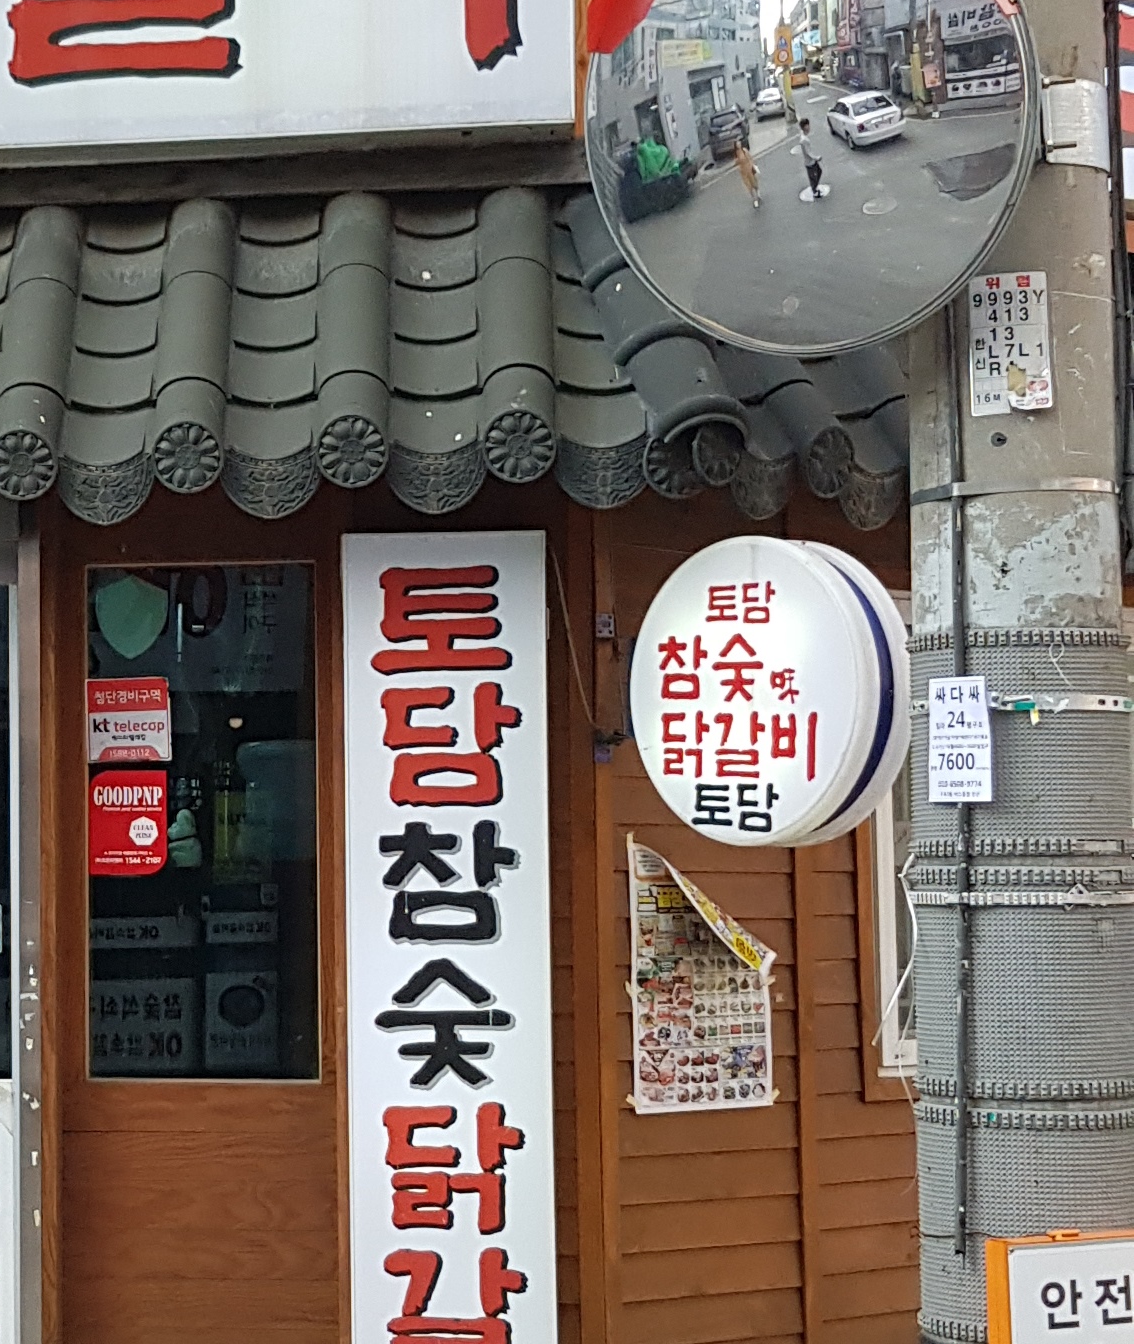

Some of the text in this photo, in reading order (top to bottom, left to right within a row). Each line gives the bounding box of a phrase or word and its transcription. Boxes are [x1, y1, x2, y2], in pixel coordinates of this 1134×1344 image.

[705, 580, 777, 625] 토담
[657, 633, 763, 703] 참숯
[93, 718, 165, 734] kt telecop
[660, 711, 818, 782] 닭갈비
[938, 753, 975, 770] 7600
[94, 786, 163, 806] GOODPNP
[691, 783, 780, 833] 토담
